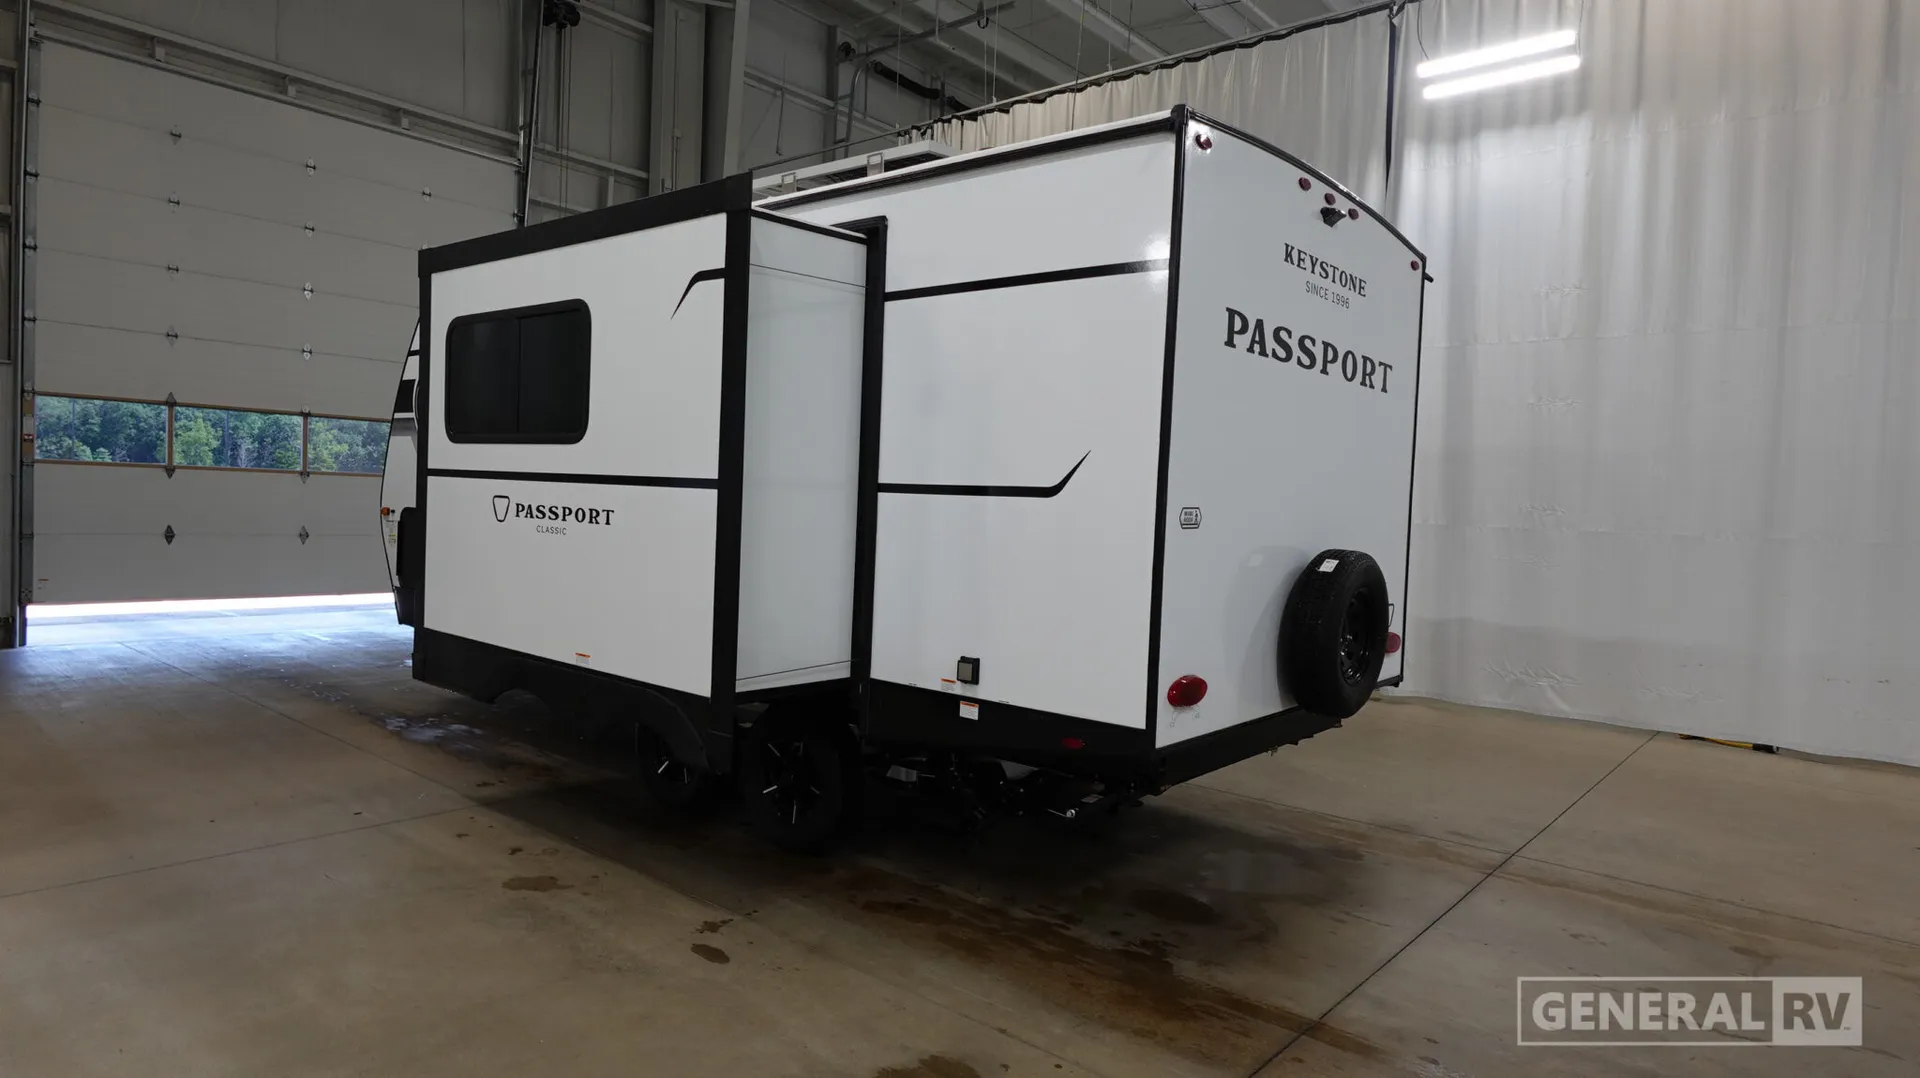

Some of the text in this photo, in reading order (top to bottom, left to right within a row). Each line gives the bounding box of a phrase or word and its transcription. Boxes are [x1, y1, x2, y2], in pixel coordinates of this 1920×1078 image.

[1284, 242, 1367, 297] KEYSTONE
[1305, 280, 1350, 310] SINCE 1996
[1224, 306, 1393, 394] PASSPORT
[515, 503, 615, 526] PASSPORT
[536, 525, 567, 535] CLASSIC
